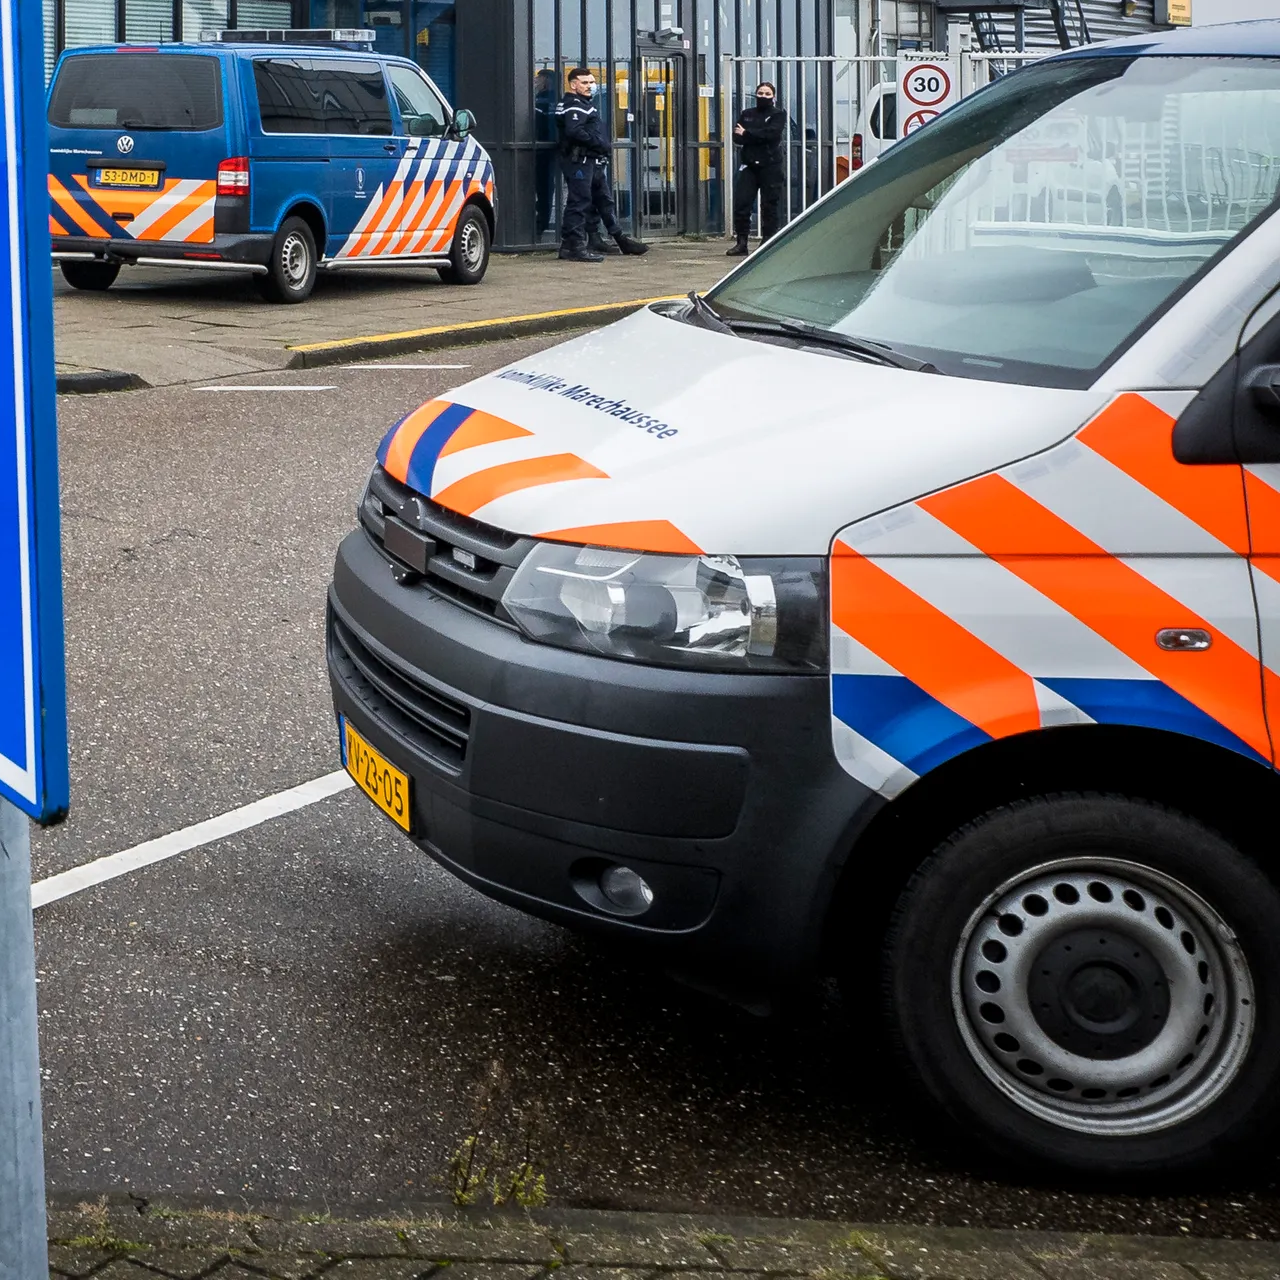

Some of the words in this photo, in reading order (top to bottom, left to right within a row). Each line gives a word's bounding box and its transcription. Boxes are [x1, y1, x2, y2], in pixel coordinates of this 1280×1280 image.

[913, 76, 940, 93] 30
[104, 170, 155, 183] 53-DMD-1
[557, 384, 679, 440] Marechaussee
[347, 730, 404, 817] KV-23-05
